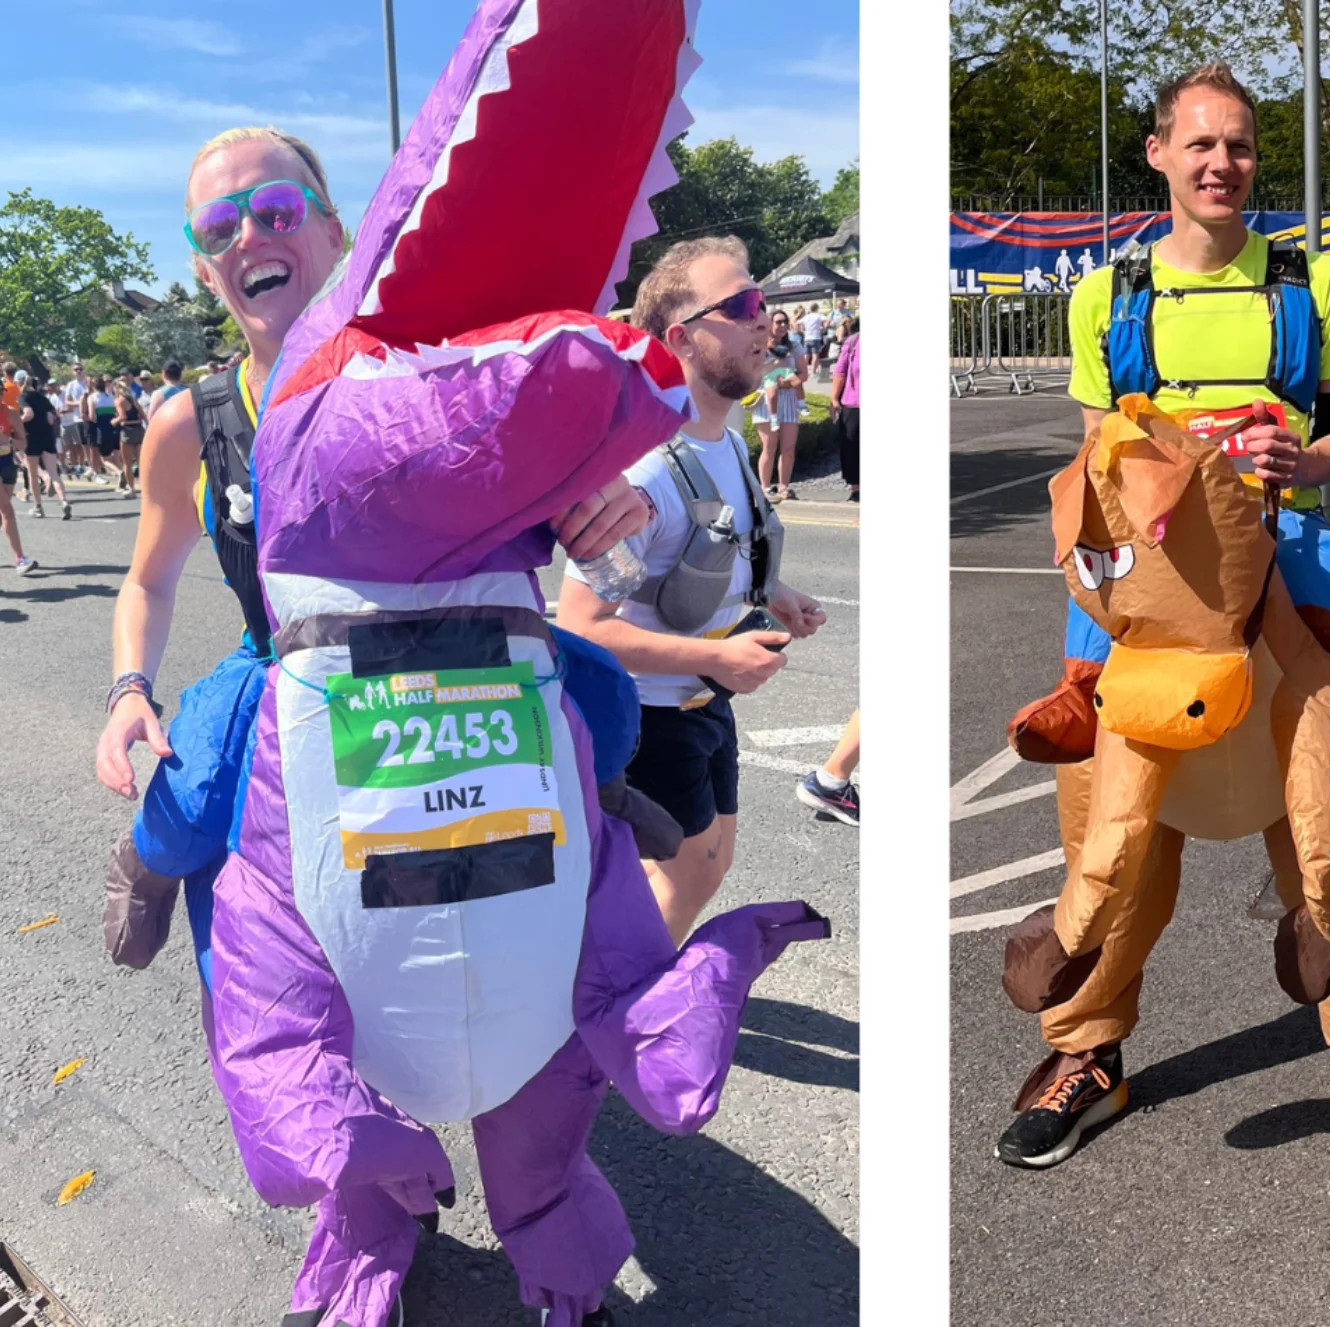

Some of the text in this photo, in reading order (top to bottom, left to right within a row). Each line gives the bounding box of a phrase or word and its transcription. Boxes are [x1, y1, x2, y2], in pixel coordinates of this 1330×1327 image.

[950, 269, 983, 293] LL
[391, 674, 435, 690] LEEDS
[394, 684, 521, 706] HALF MARATHON
[372, 709, 518, 767] 22453
[424, 785, 486, 813] LINZ
